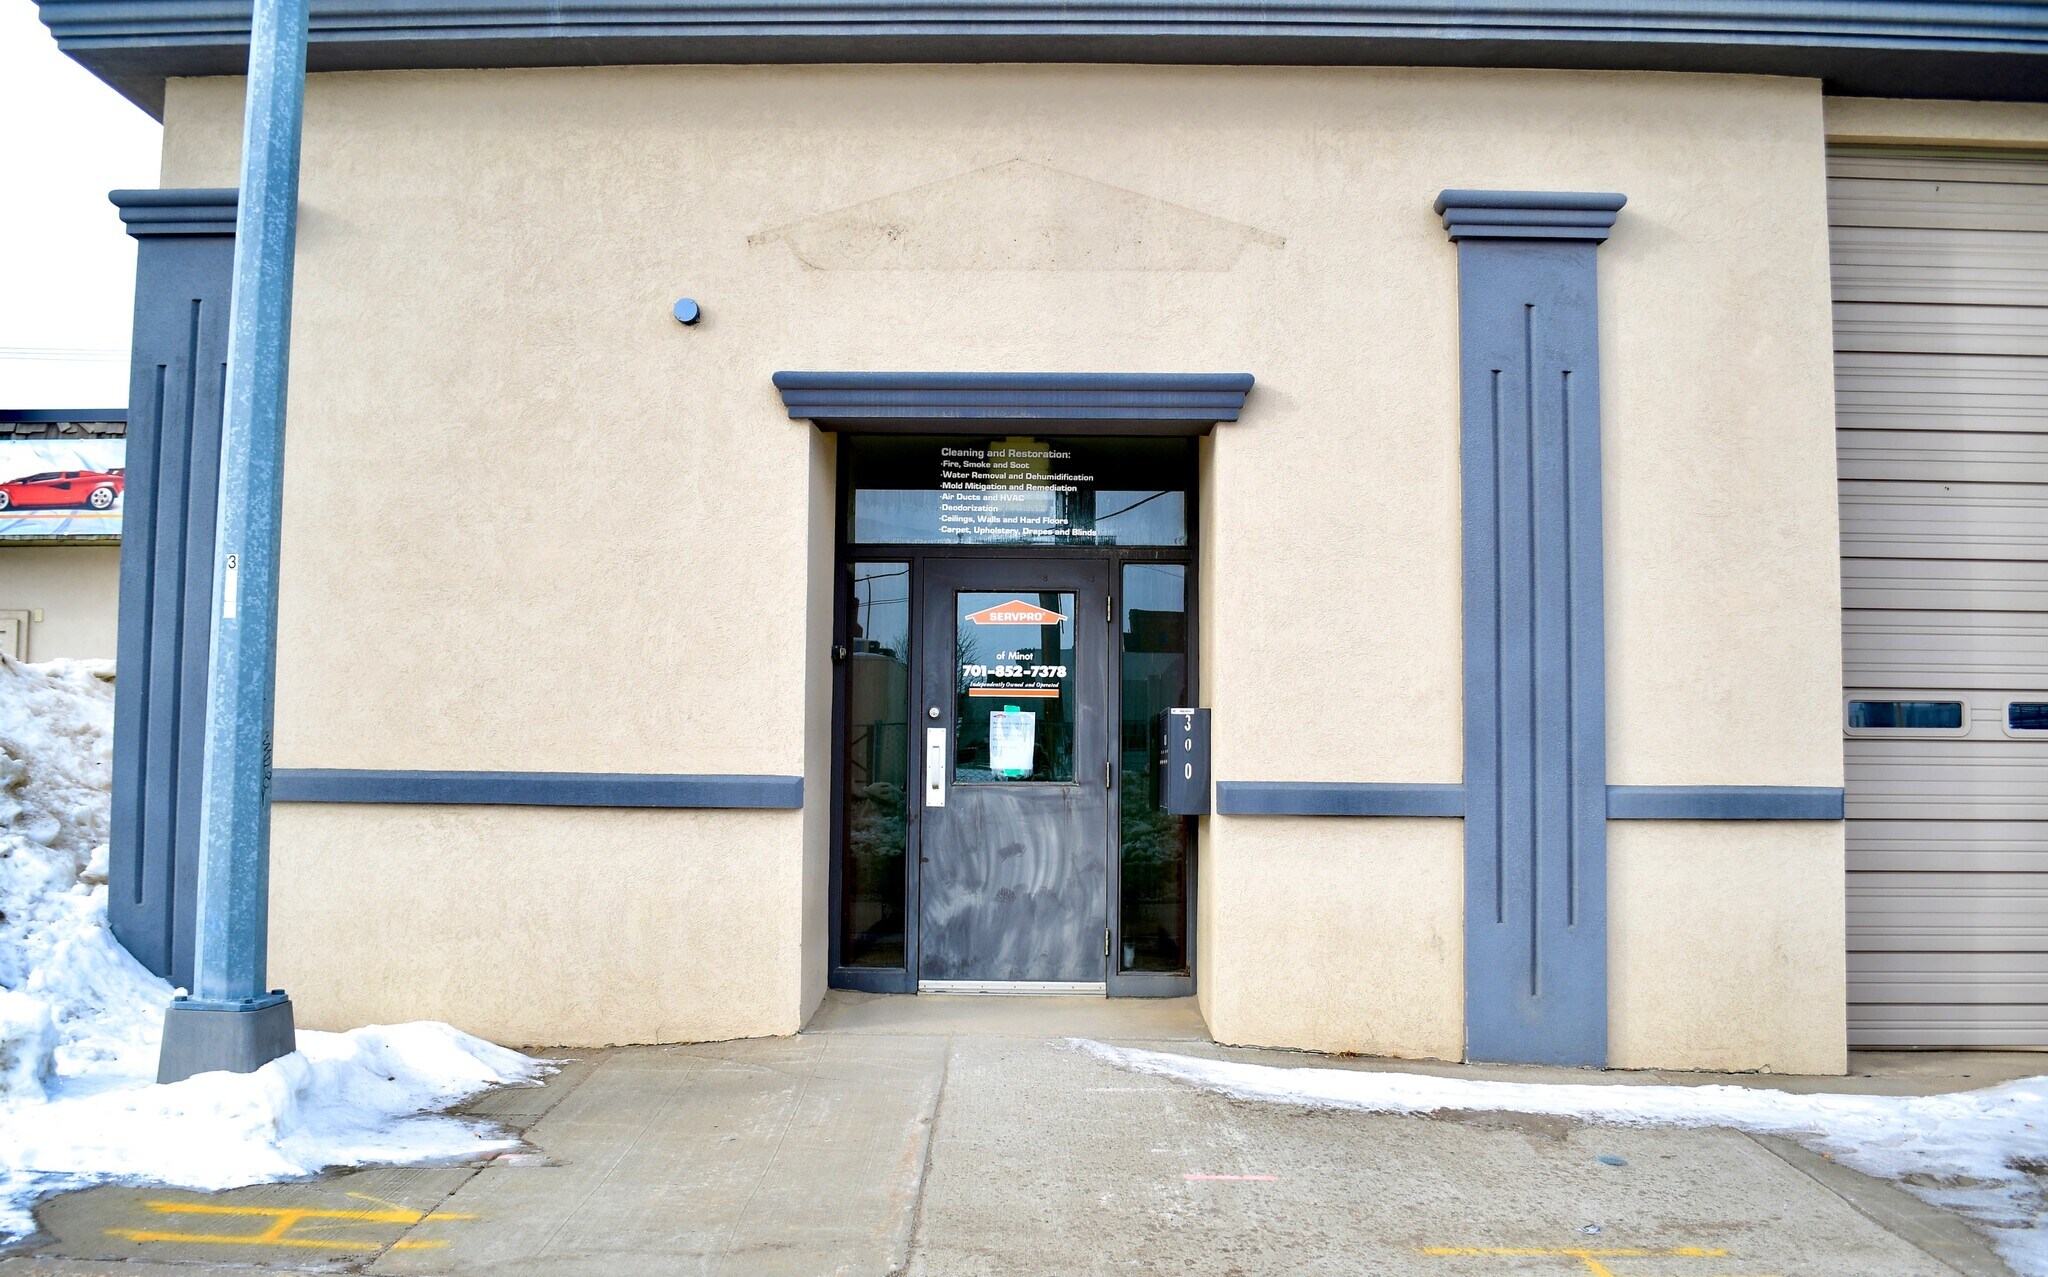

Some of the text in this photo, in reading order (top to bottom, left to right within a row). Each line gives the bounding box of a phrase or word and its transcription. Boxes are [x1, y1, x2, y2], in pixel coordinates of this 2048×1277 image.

[941, 447, 1071, 459] Cleaning and Restoration:
[963, 460, 991, 468] Smoke
[1010, 461, 1030, 469] Soot
[971, 471, 1007, 479] Removal
[1008, 472, 1023, 480] and
[1025, 472, 1094, 481] Dehumidification
[964, 482, 1007, 491] Mitigation
[1008, 483, 1023, 491] and
[1026, 483, 1077, 492] Remediation
[956, 493, 981, 501] Ducts
[983, 493, 998, 501] and
[1000, 494, 1025, 502] HVAC
[977, 515, 1001, 523] Walls
[1020, 516, 1041, 524] Hard
[1042, 516, 1069, 525] Floors
[1022, 527, 1053, 537] Drapes
[1054, 528, 1070, 536] and
[1071, 528, 1097, 536] Blinds
[228, 554, 237, 569] 3
[996, 651, 1034, 660] of Minot
[962, 665, 1067, 678] 701-852-7378
[969, 681, 1005, 689] Independently
[1036, 681, 1060, 689] Operated
